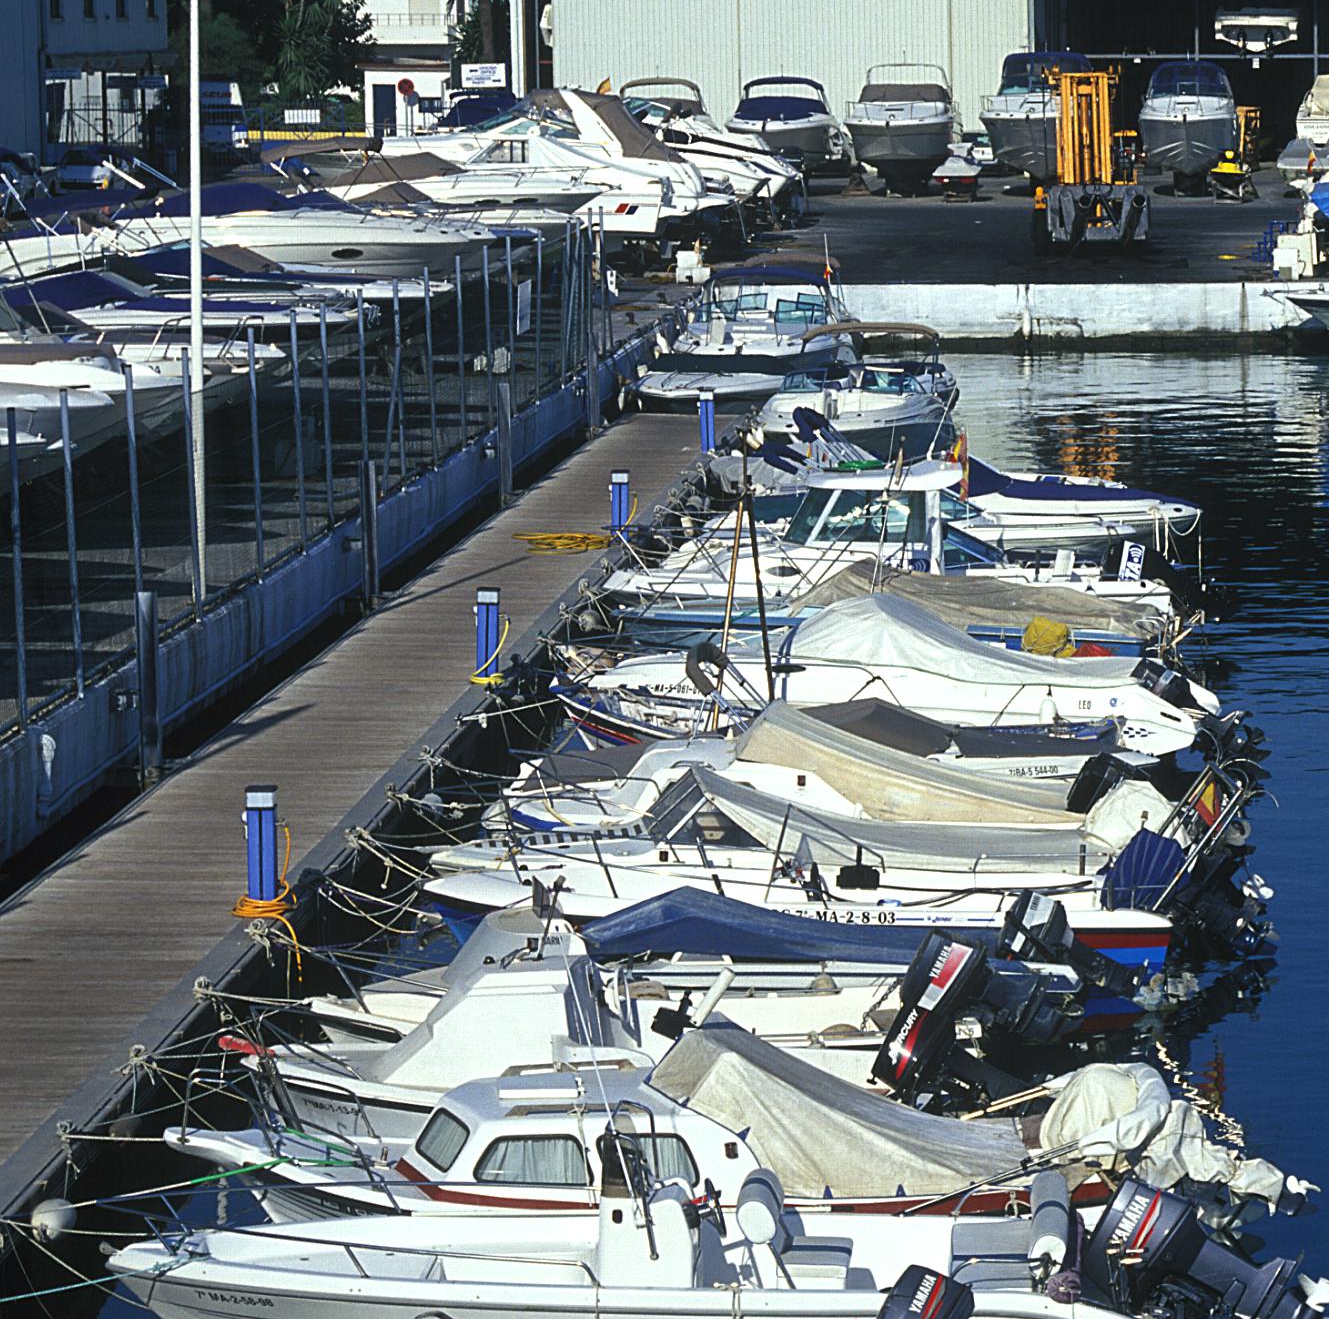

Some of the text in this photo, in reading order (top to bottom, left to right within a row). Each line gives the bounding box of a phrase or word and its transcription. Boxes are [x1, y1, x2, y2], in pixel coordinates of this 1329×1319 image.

[1079, 700, 1092, 709] LEO
[929, 945, 953, 979] YAMAHA
[1111, 1195, 1150, 1244] YAMAHA
[909, 1274, 937, 1313] YAMAHA
